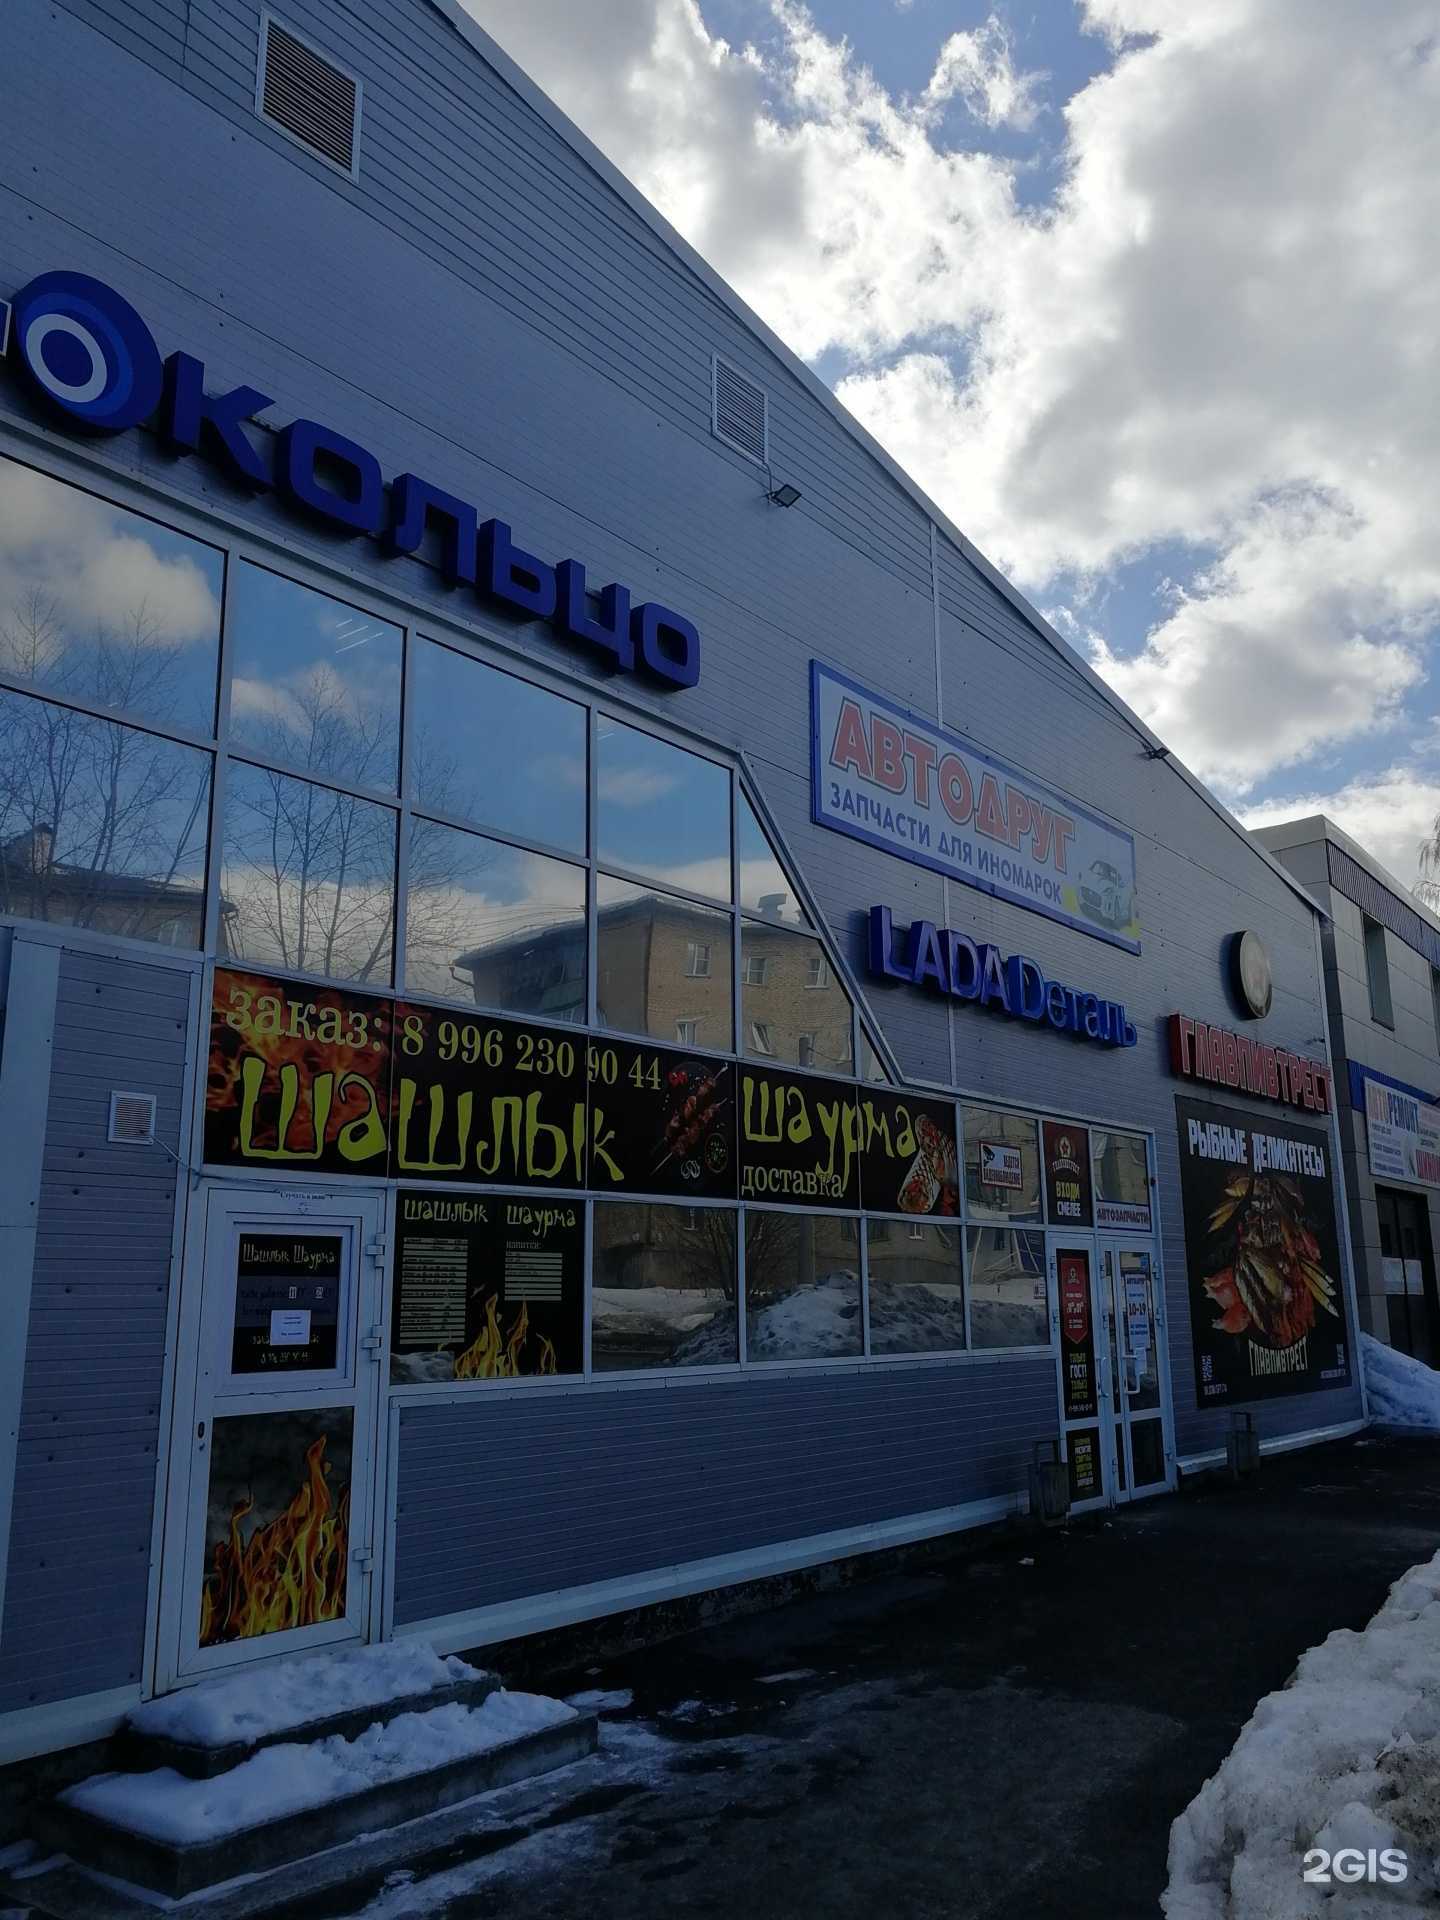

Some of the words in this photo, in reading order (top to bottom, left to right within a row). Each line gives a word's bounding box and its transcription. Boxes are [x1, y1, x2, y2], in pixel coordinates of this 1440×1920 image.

[829, 696, 1076, 874] АВТОДРУГ
[830, 781, 930, 847] ЗАПЧАСТИ
[938, 831, 972, 864] ДЛЯ
[977, 848, 1062, 905] ИНОМАРОК
[867, 904, 1011, 1012] LADA
[402, 1015, 424, 1056] 8
[437, 1021, 504, 1067] 996
[515, 1034, 575, 1078] 230
[586, 1045, 619, 1085] 90
[628, 1052, 662, 1090] 44
[1176, 1014, 1333, 1115] ГЛАВПИВТРЕСТ
[741, 1165, 845, 1198] доставка
[1187, 1118, 1249, 1165] РЫБНЫЕ
[1251, 1131, 1327, 1179] ДЕЛИКАТЕСЫ
[1055, 1180, 1081, 1201] ВХОДИ
[1056, 1200, 1082, 1217] СМЕЛЕЕ
[1248, 1335, 1309, 1377] ГЛАВПИВТРЕСТ
